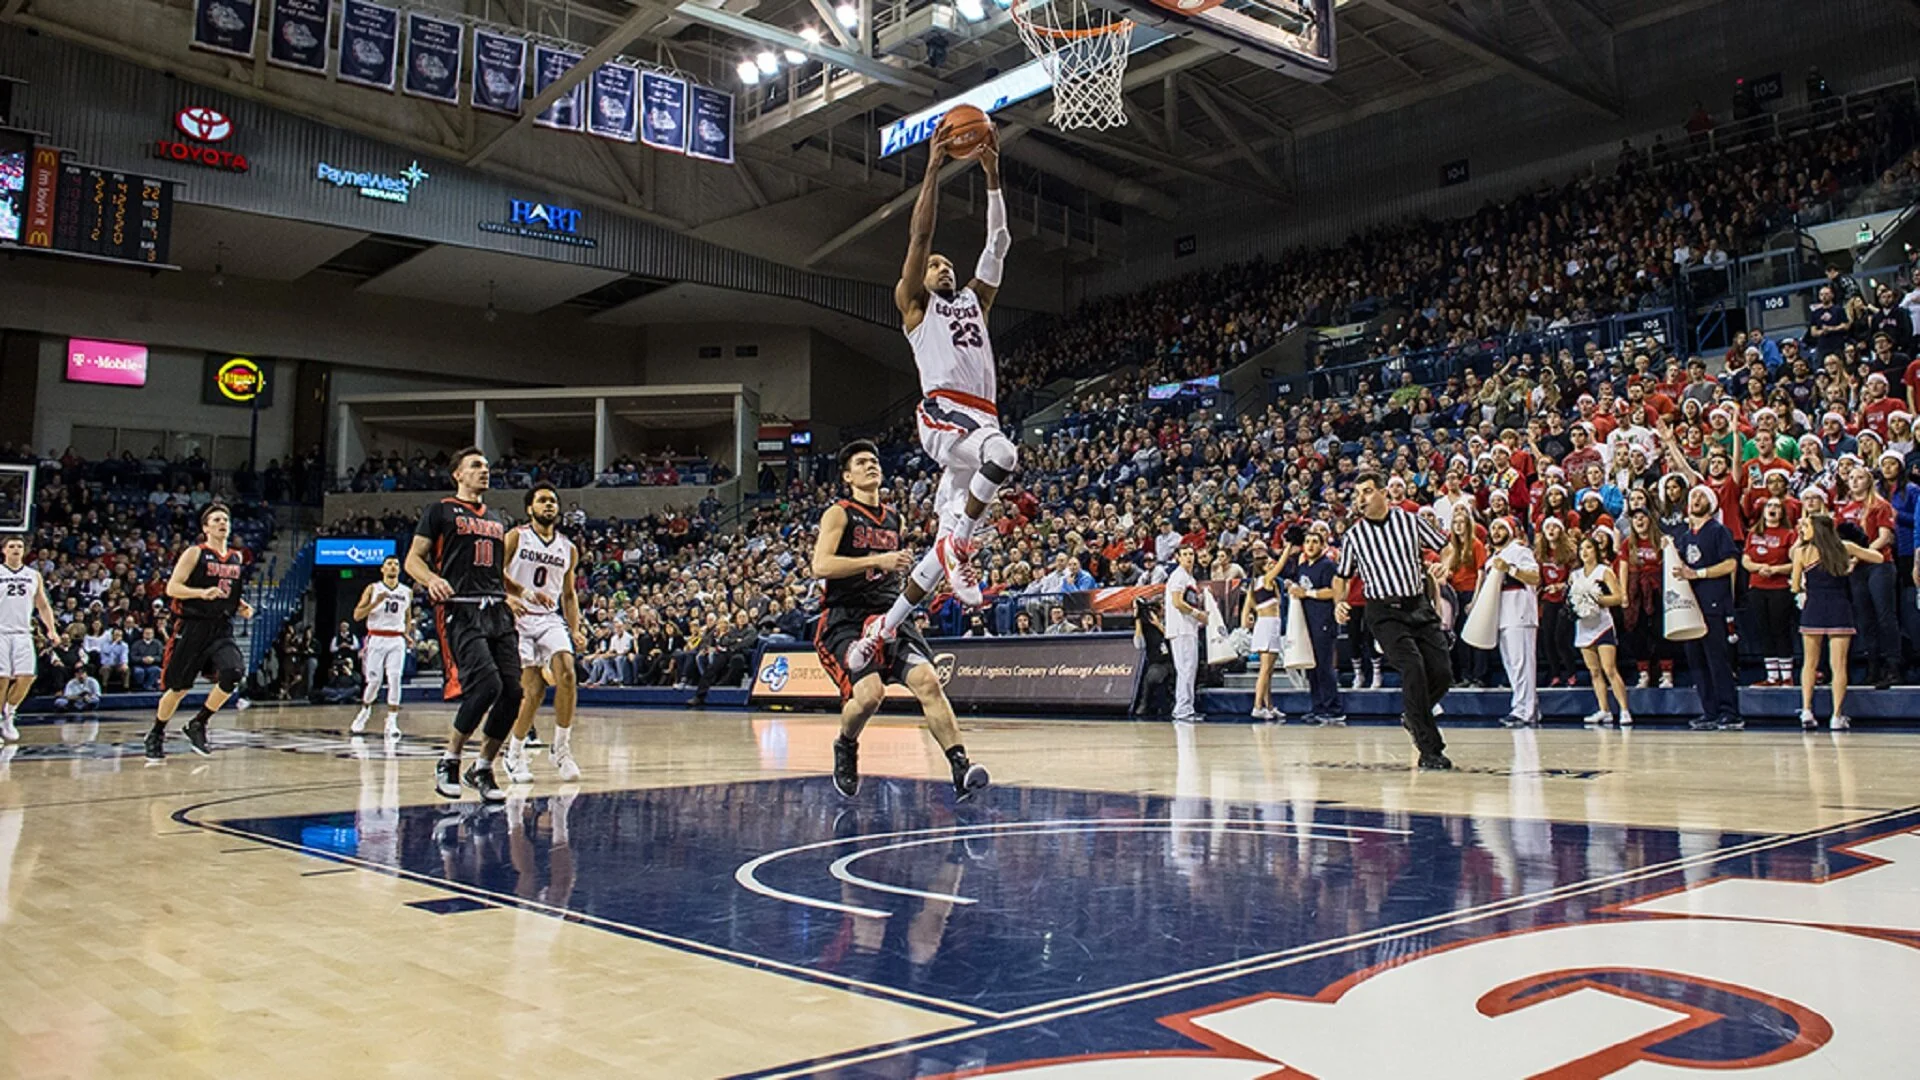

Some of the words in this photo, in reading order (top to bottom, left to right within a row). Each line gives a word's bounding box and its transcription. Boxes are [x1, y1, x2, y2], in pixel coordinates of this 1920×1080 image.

[1753, 81, 1778, 97] 105
[158, 140, 249, 171] TOYOTA
[317, 162, 410, 193] PayneWest
[510, 199, 582, 233] HART
[949, 321, 984, 348] 23
[473, 540, 494, 567] 10
[533, 566, 548, 588] 0
[7, 583, 27, 597] 25
[383, 601, 399, 614] 10
[957, 665, 982, 677] Official
[982, 665, 1012, 679] Logistics
[1013, 665, 1046, 679] Company
[1058, 665, 1093, 679] Gonzaga
[1093, 664, 1133, 676] Athletics
